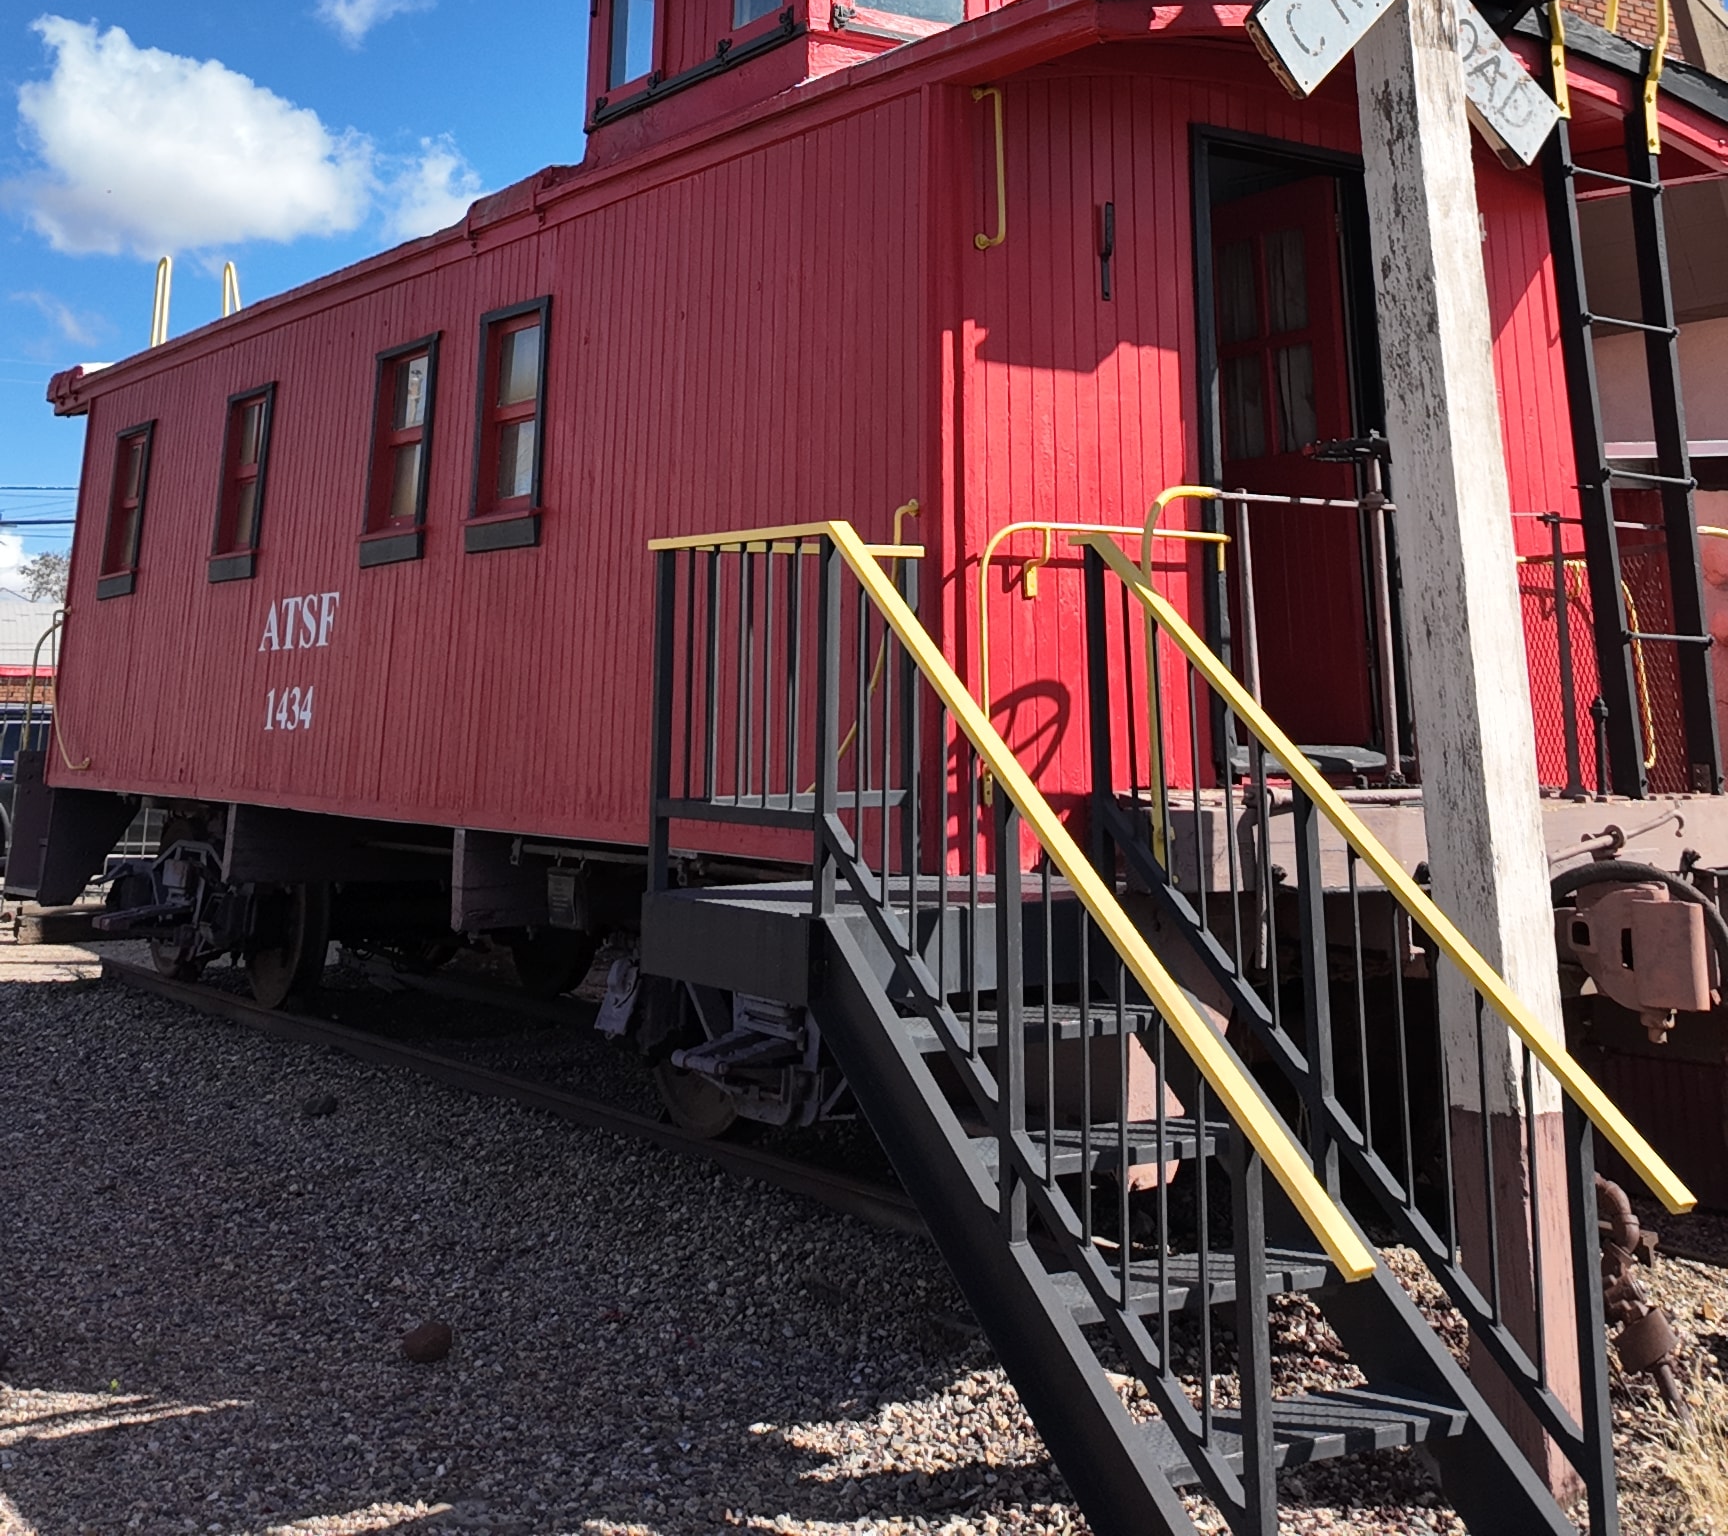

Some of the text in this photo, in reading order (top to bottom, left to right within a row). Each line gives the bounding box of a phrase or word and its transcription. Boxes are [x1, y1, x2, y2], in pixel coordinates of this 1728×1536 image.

[1458, 17, 1534, 128] OAD
[257, 591, 340, 652] ATSF
[263, 685, 314, 731] 1434
